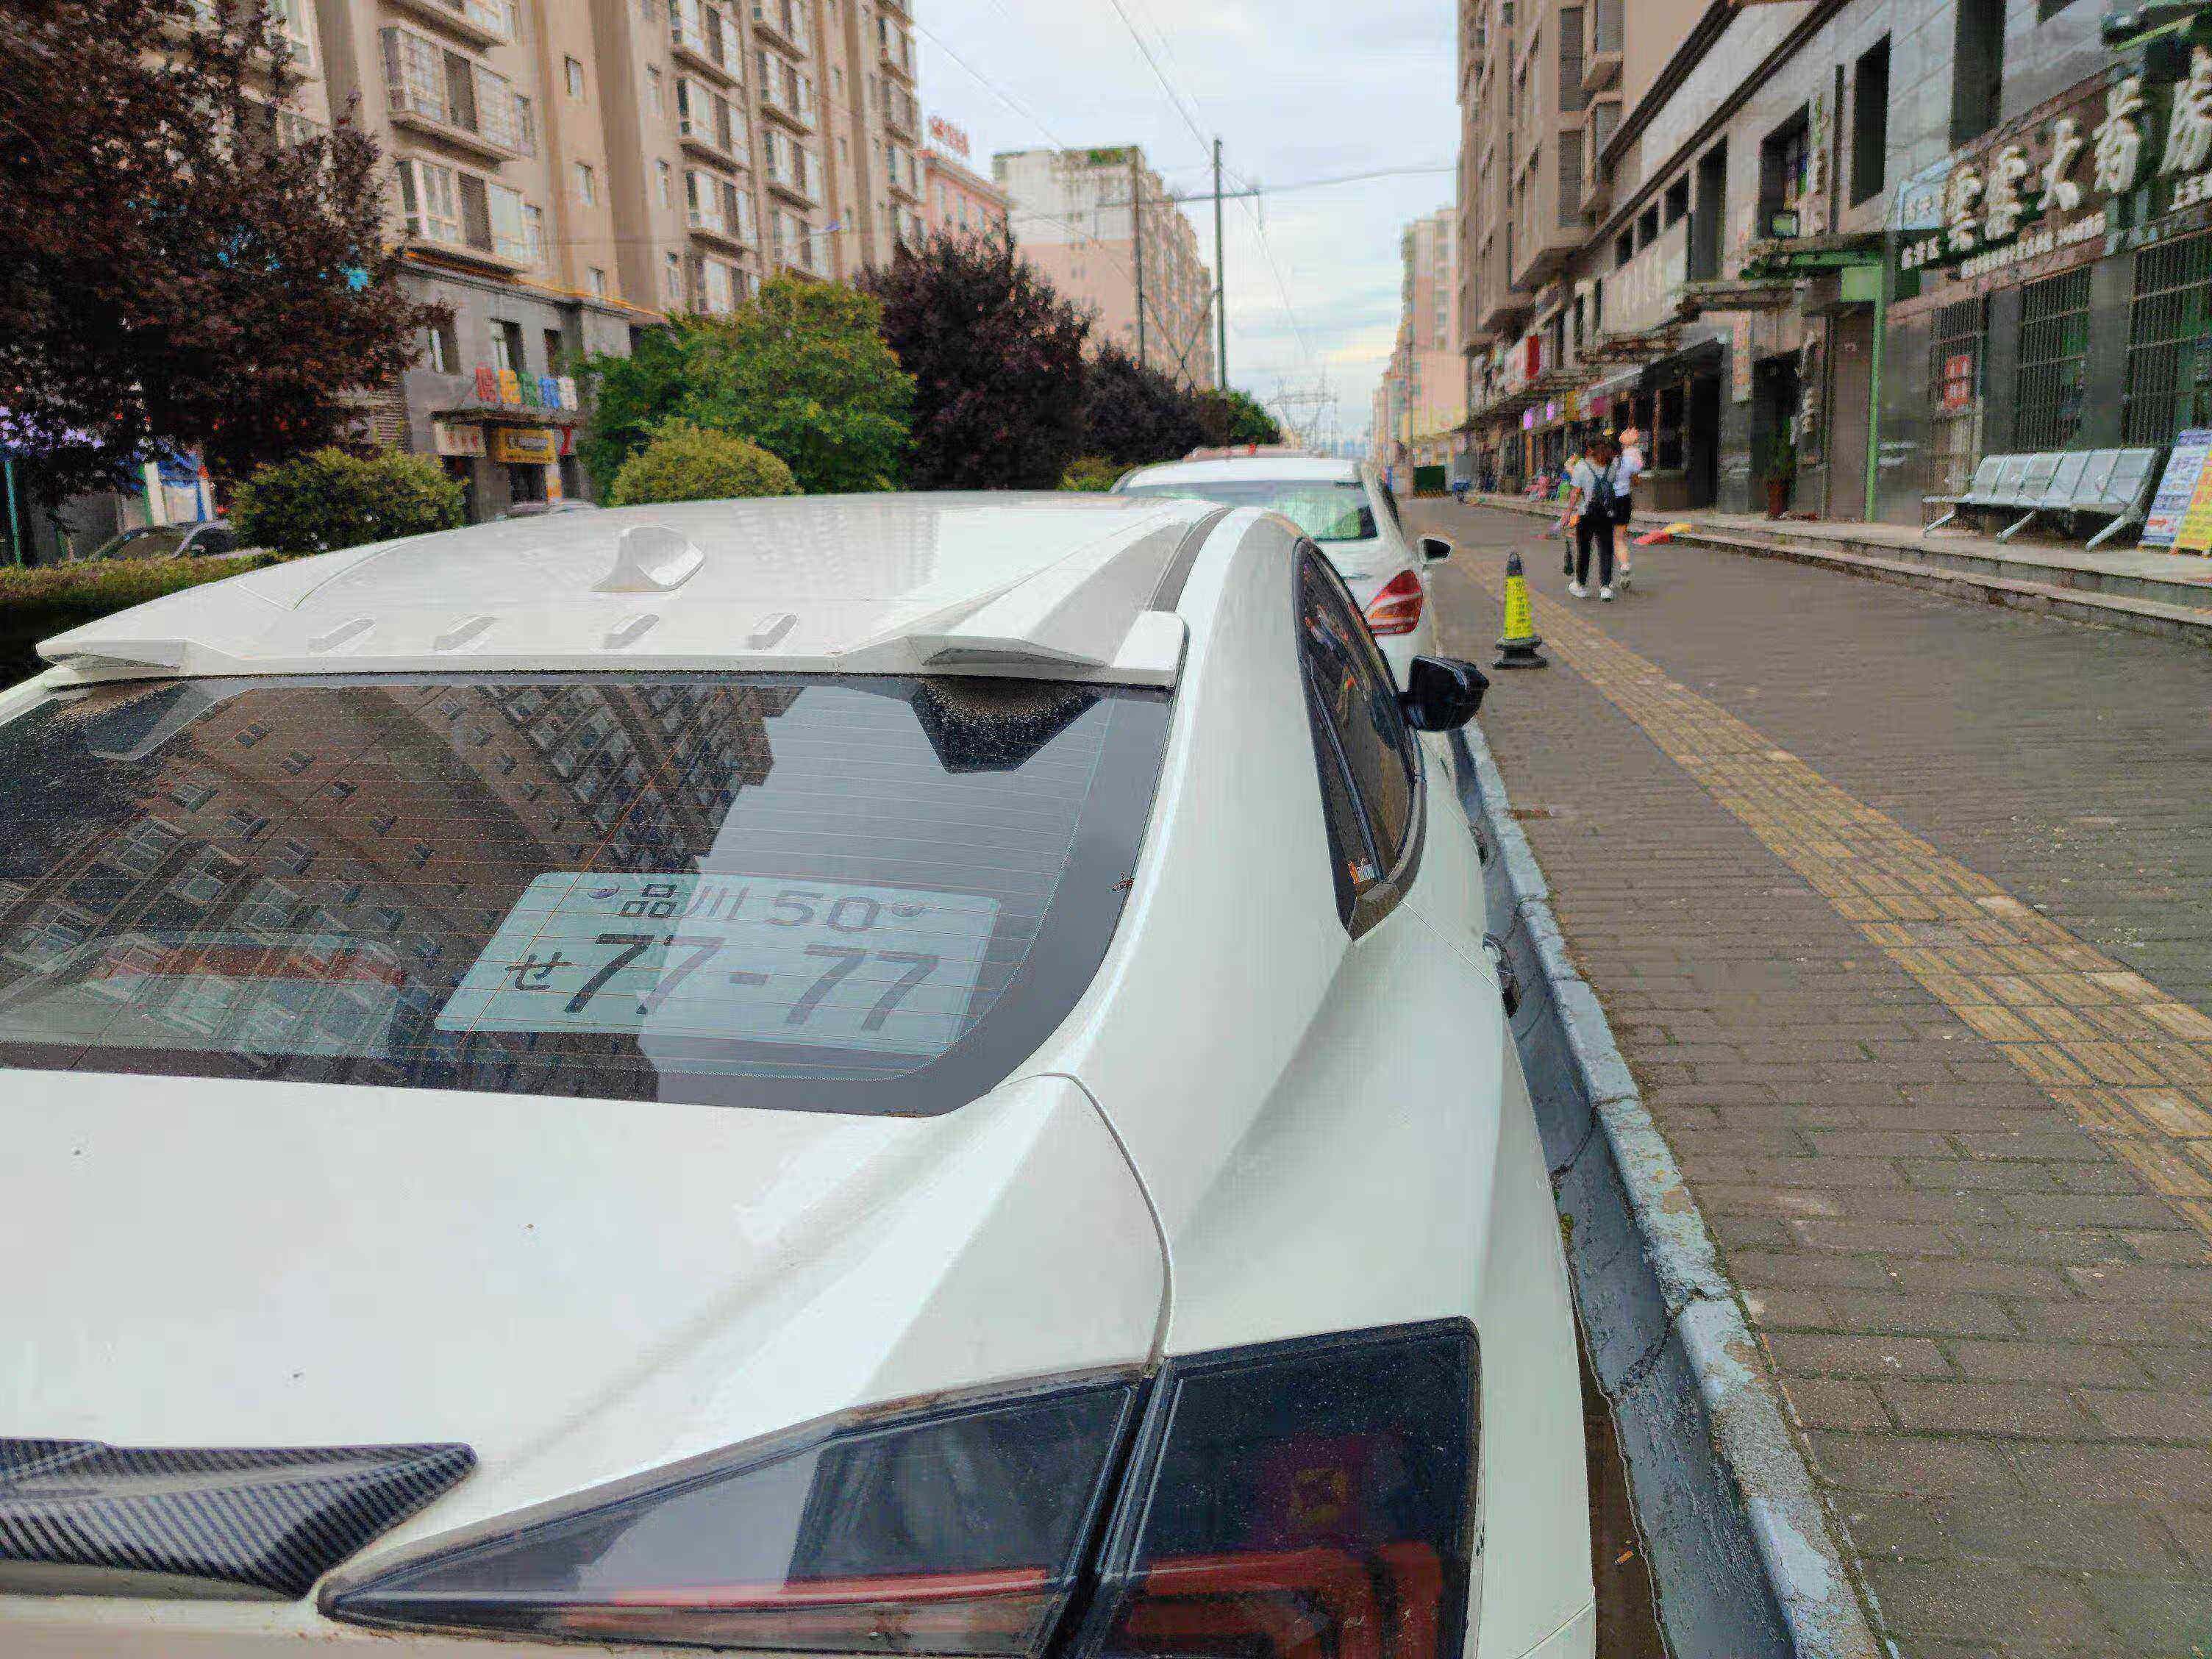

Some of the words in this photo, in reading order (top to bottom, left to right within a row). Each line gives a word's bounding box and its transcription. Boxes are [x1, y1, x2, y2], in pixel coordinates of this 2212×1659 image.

[619, 884, 752, 919] 品川
[765, 890, 880, 932] 50
[504, 952, 571, 990] せ
[564, 932, 939, 1030] 77-77
